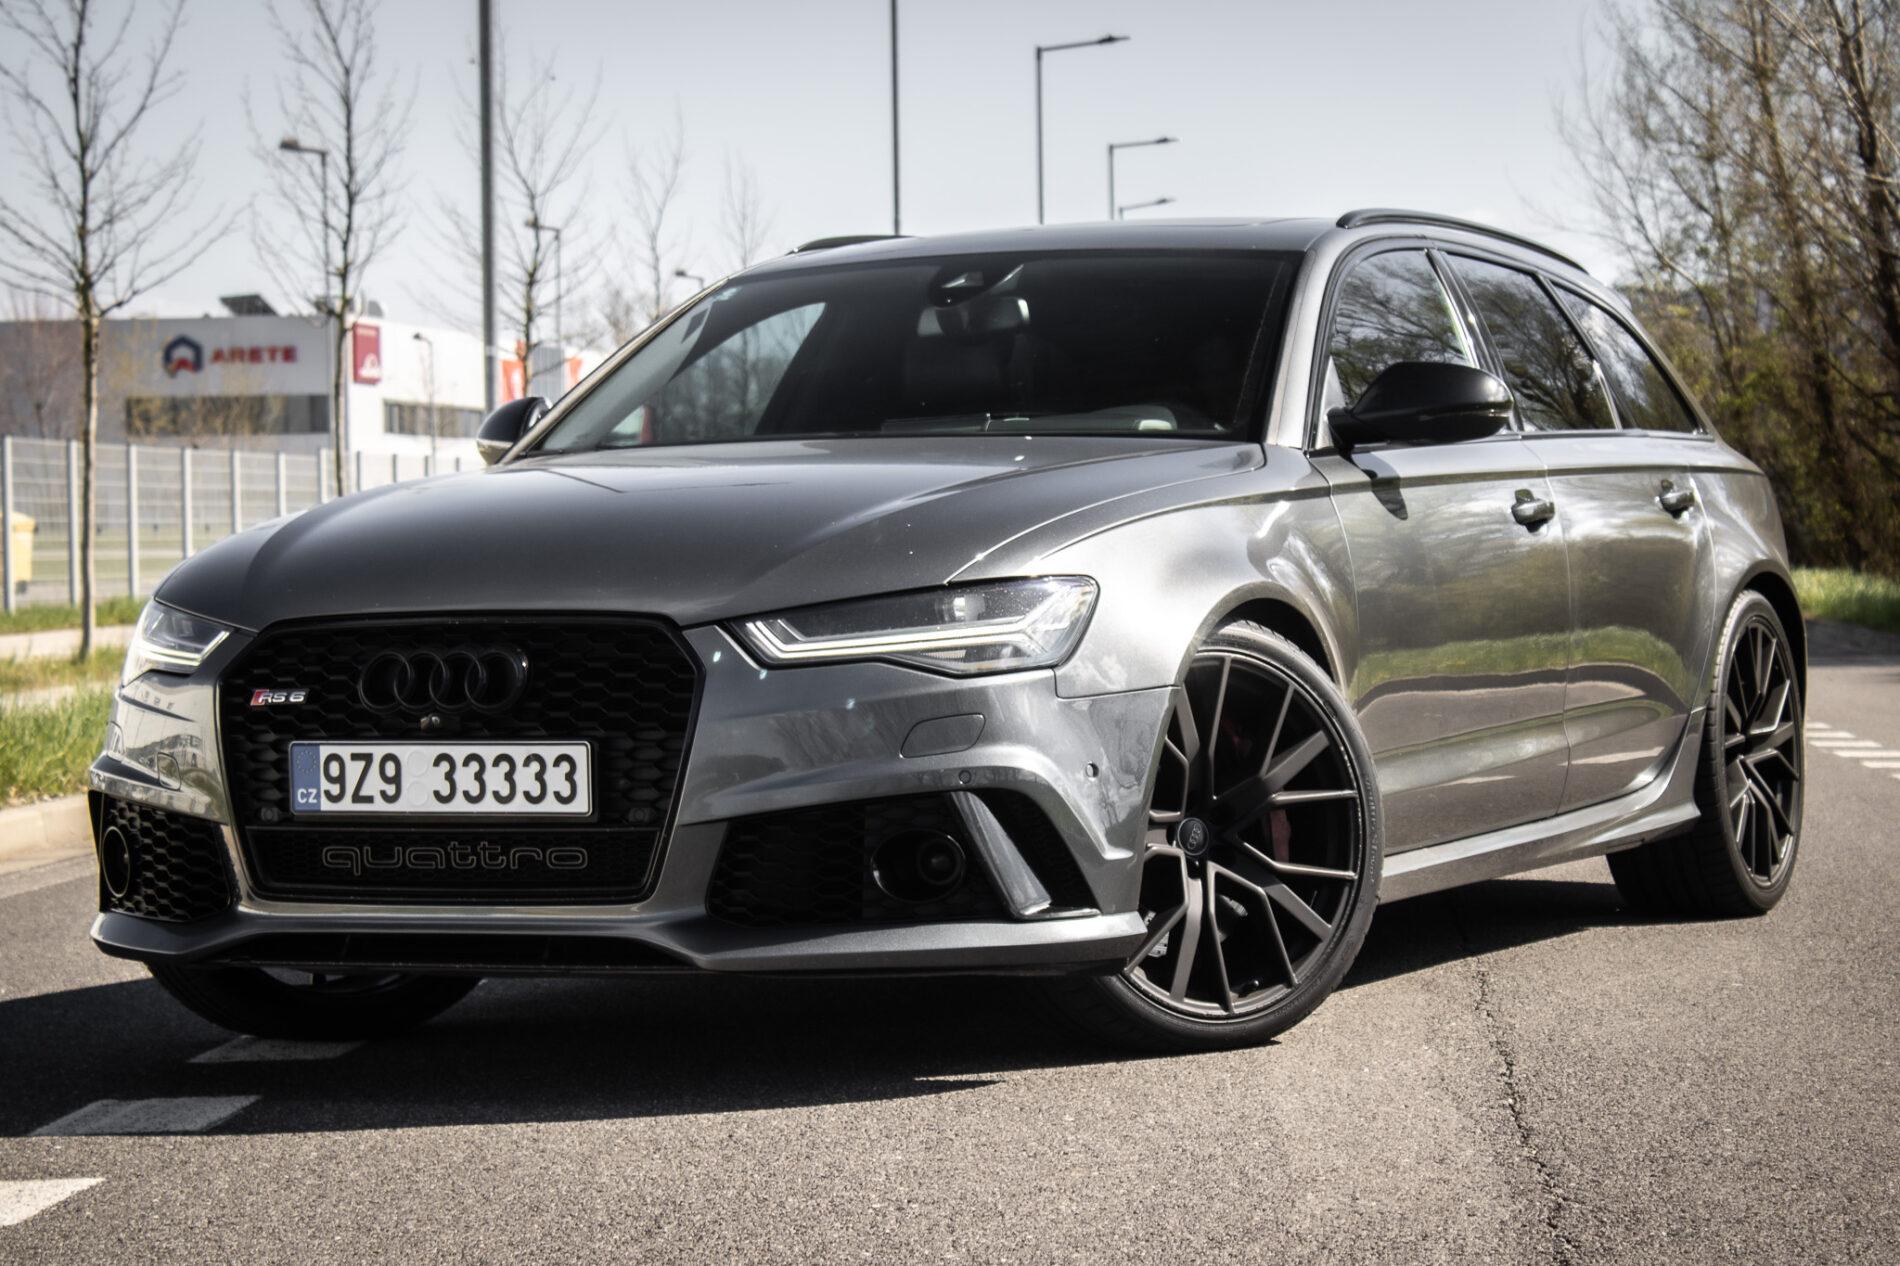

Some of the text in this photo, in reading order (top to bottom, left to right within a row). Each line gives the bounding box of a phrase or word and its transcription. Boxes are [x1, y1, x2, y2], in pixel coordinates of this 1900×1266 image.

[210, 345, 298, 363] ARETE
[323, 752, 578, 805] 9Z9 33333
[297, 788, 318, 804] CZ
[322, 841, 588, 876] quattro
